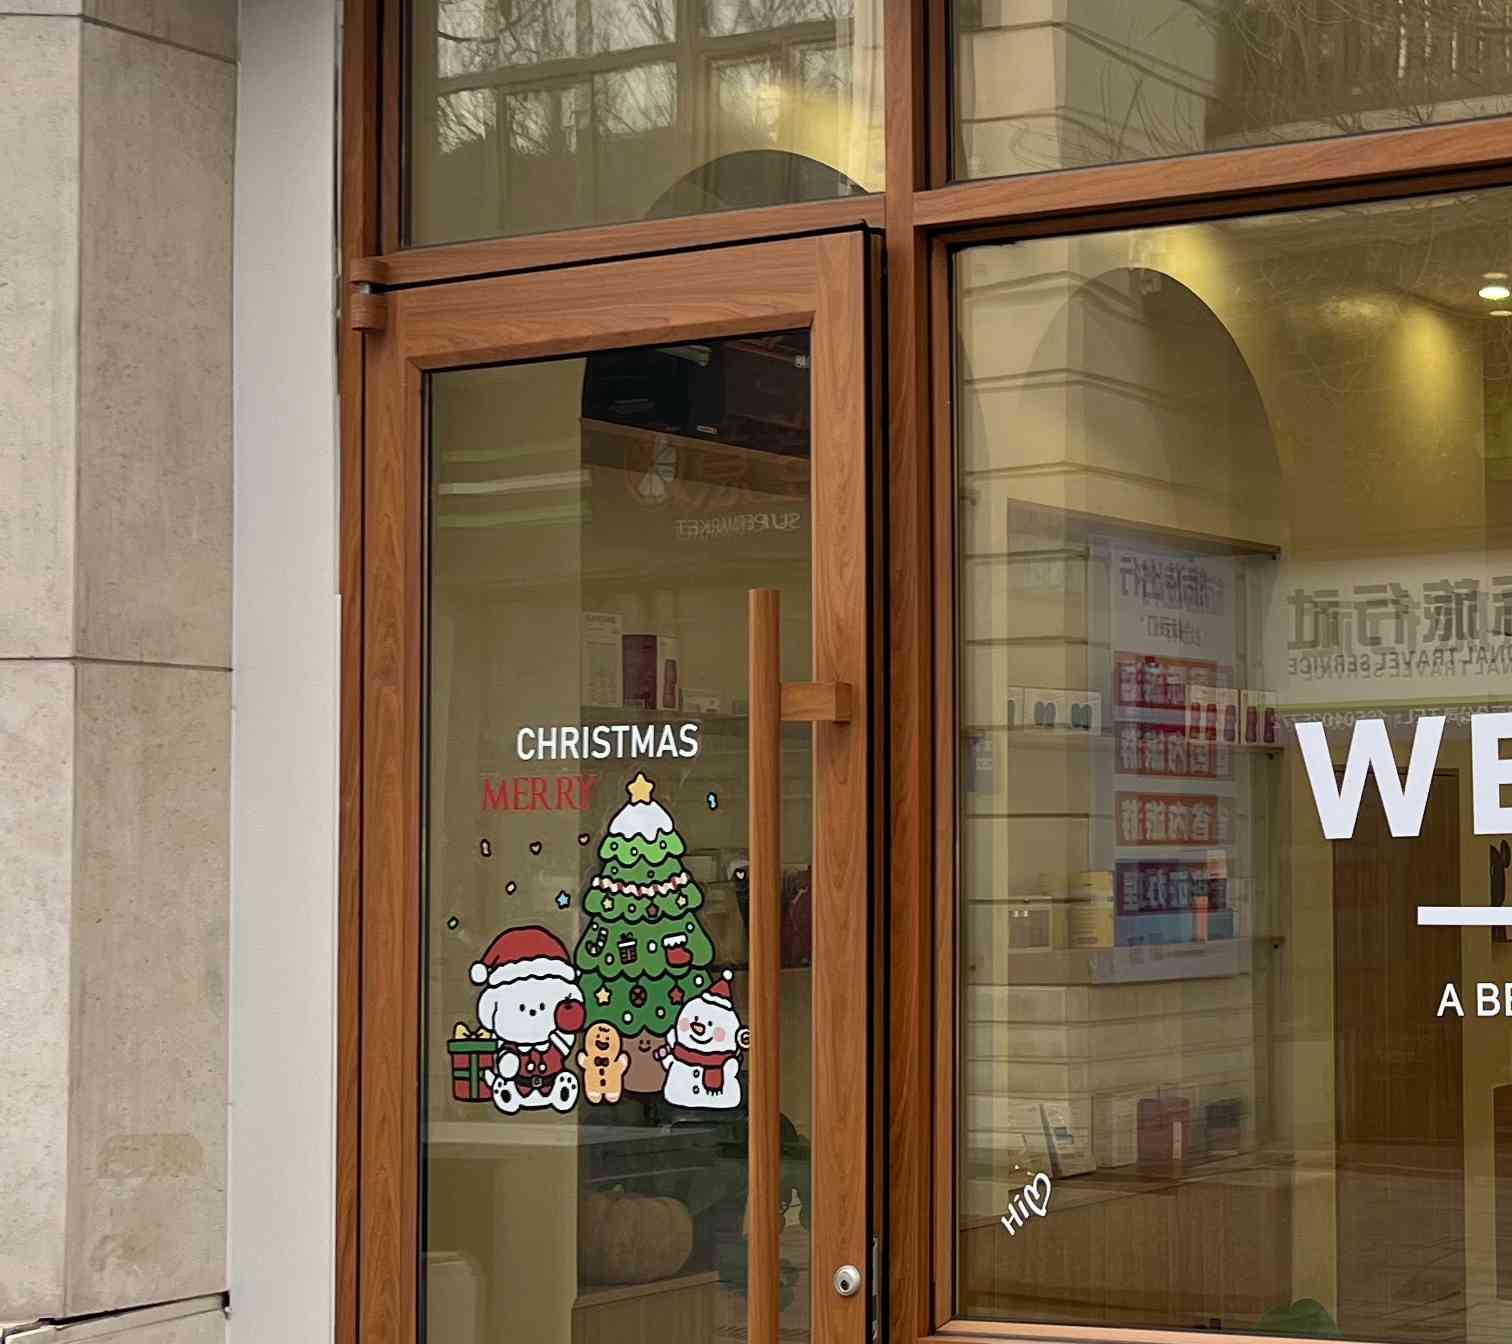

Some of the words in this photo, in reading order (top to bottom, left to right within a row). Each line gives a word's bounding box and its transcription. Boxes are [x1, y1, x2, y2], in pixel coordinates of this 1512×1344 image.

[516, 723, 699, 760] CHRISTMAS
[482, 775, 598, 812] MERRY
[1437, 983, 1465, 1017] A
